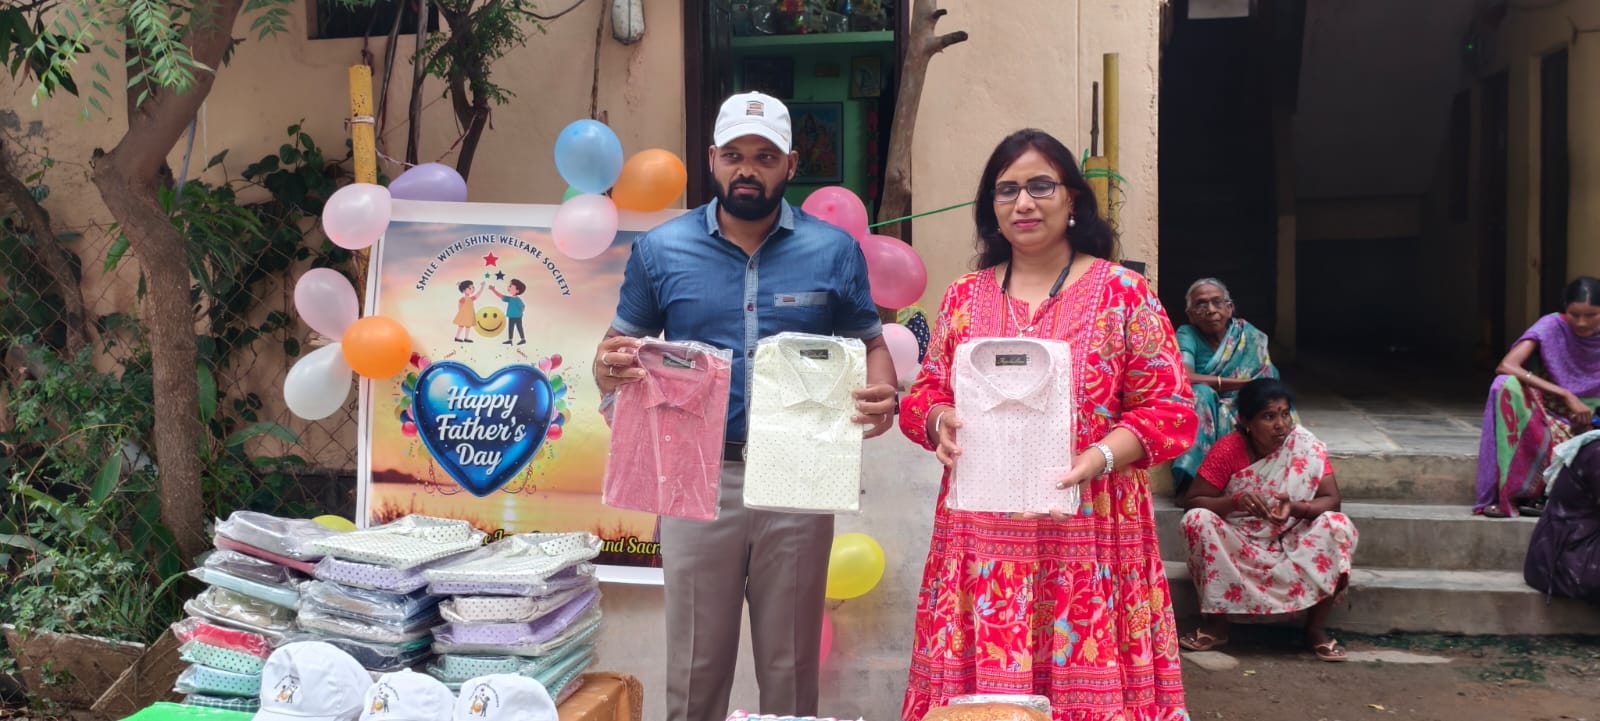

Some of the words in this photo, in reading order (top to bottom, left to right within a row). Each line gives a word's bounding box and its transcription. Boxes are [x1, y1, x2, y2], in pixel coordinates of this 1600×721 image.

[416, 262, 438, 291] SMILE
[438, 240, 463, 263] WITH
[465, 234, 496, 248] SHINE
[499, 235, 543, 259] WELFARE
[542, 257, 572, 297] SOCIETY
[447, 386, 518, 419] Happy
[436, 414, 527, 442] Father's
[455, 443, 502, 475] Day
